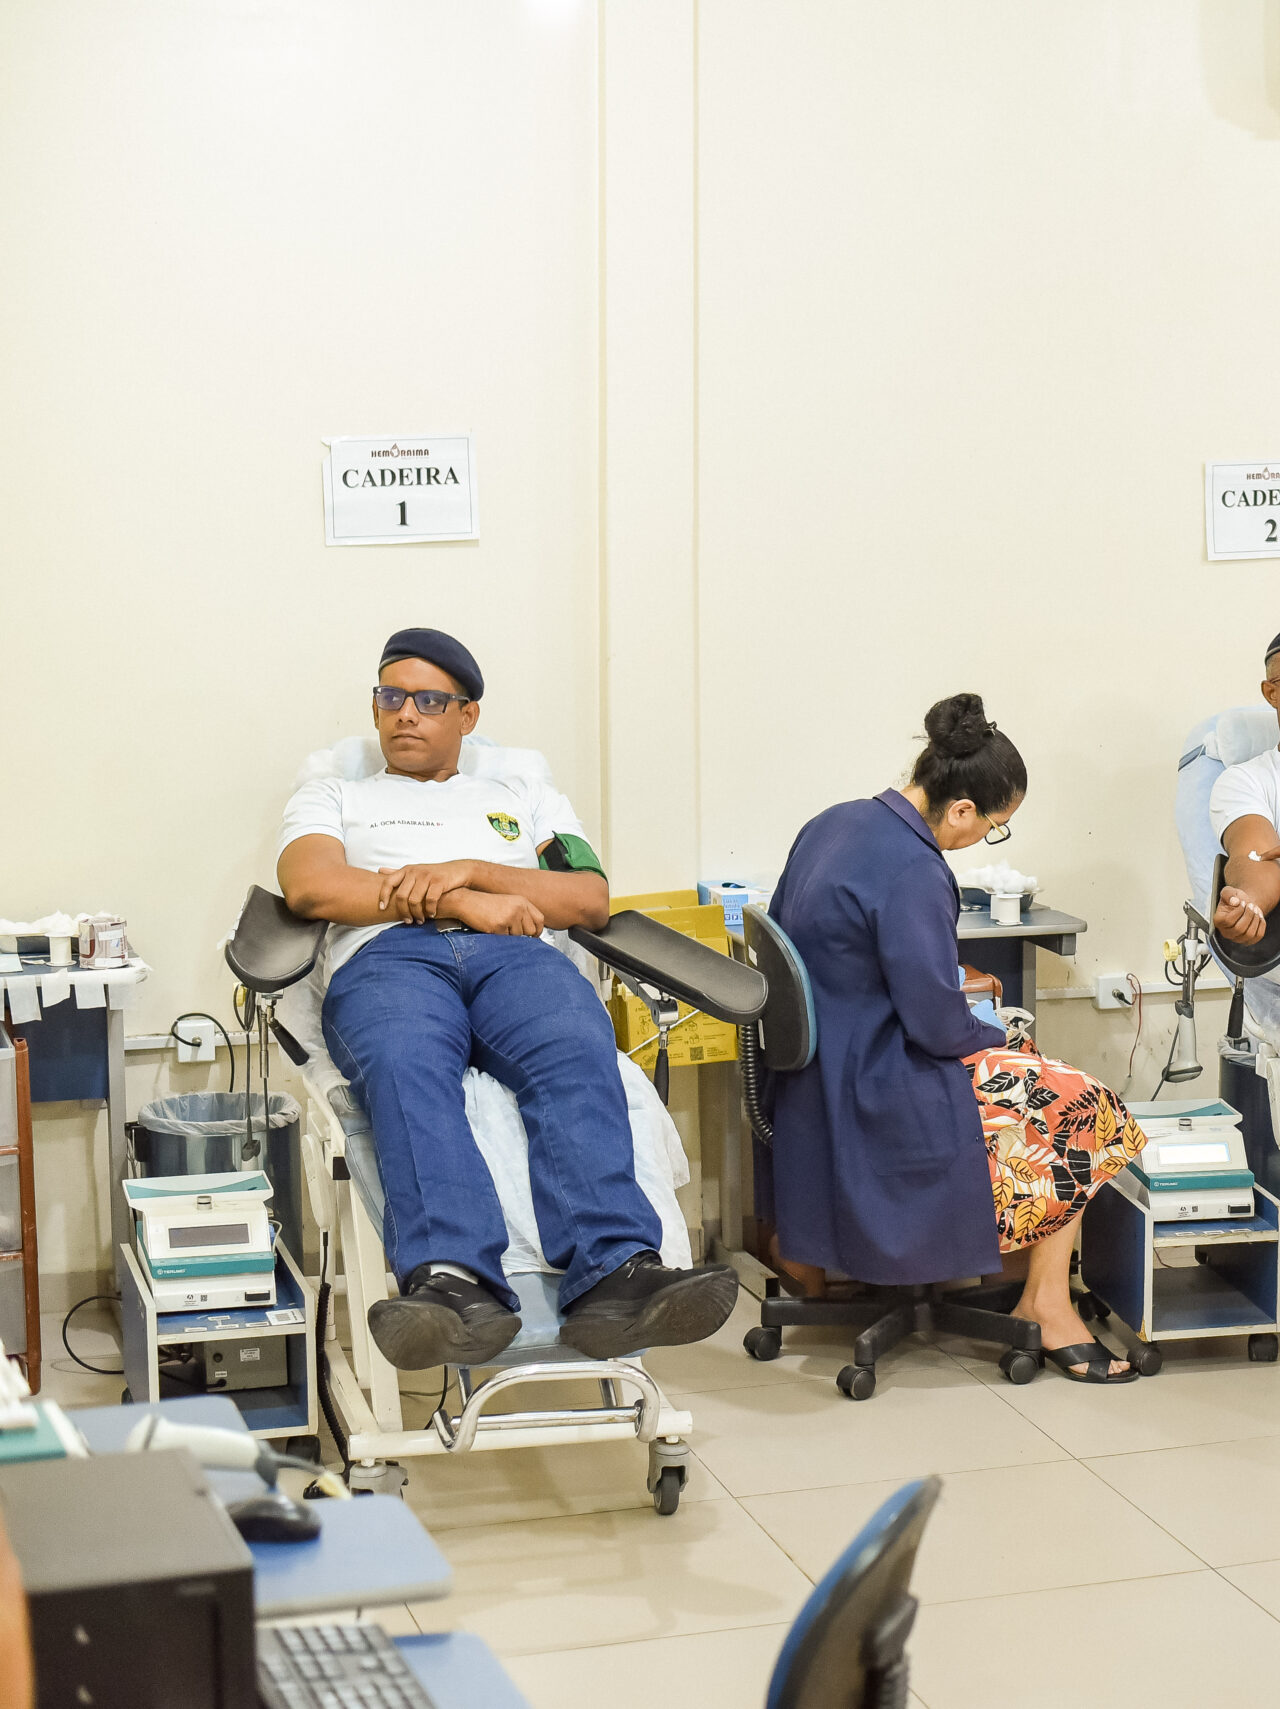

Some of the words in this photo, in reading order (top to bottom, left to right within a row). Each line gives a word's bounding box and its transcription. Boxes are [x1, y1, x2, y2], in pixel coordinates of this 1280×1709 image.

[342, 466, 459, 488] CADEIRA
[396, 501, 409, 526] 1
[1264, 518, 1278, 542] 2
